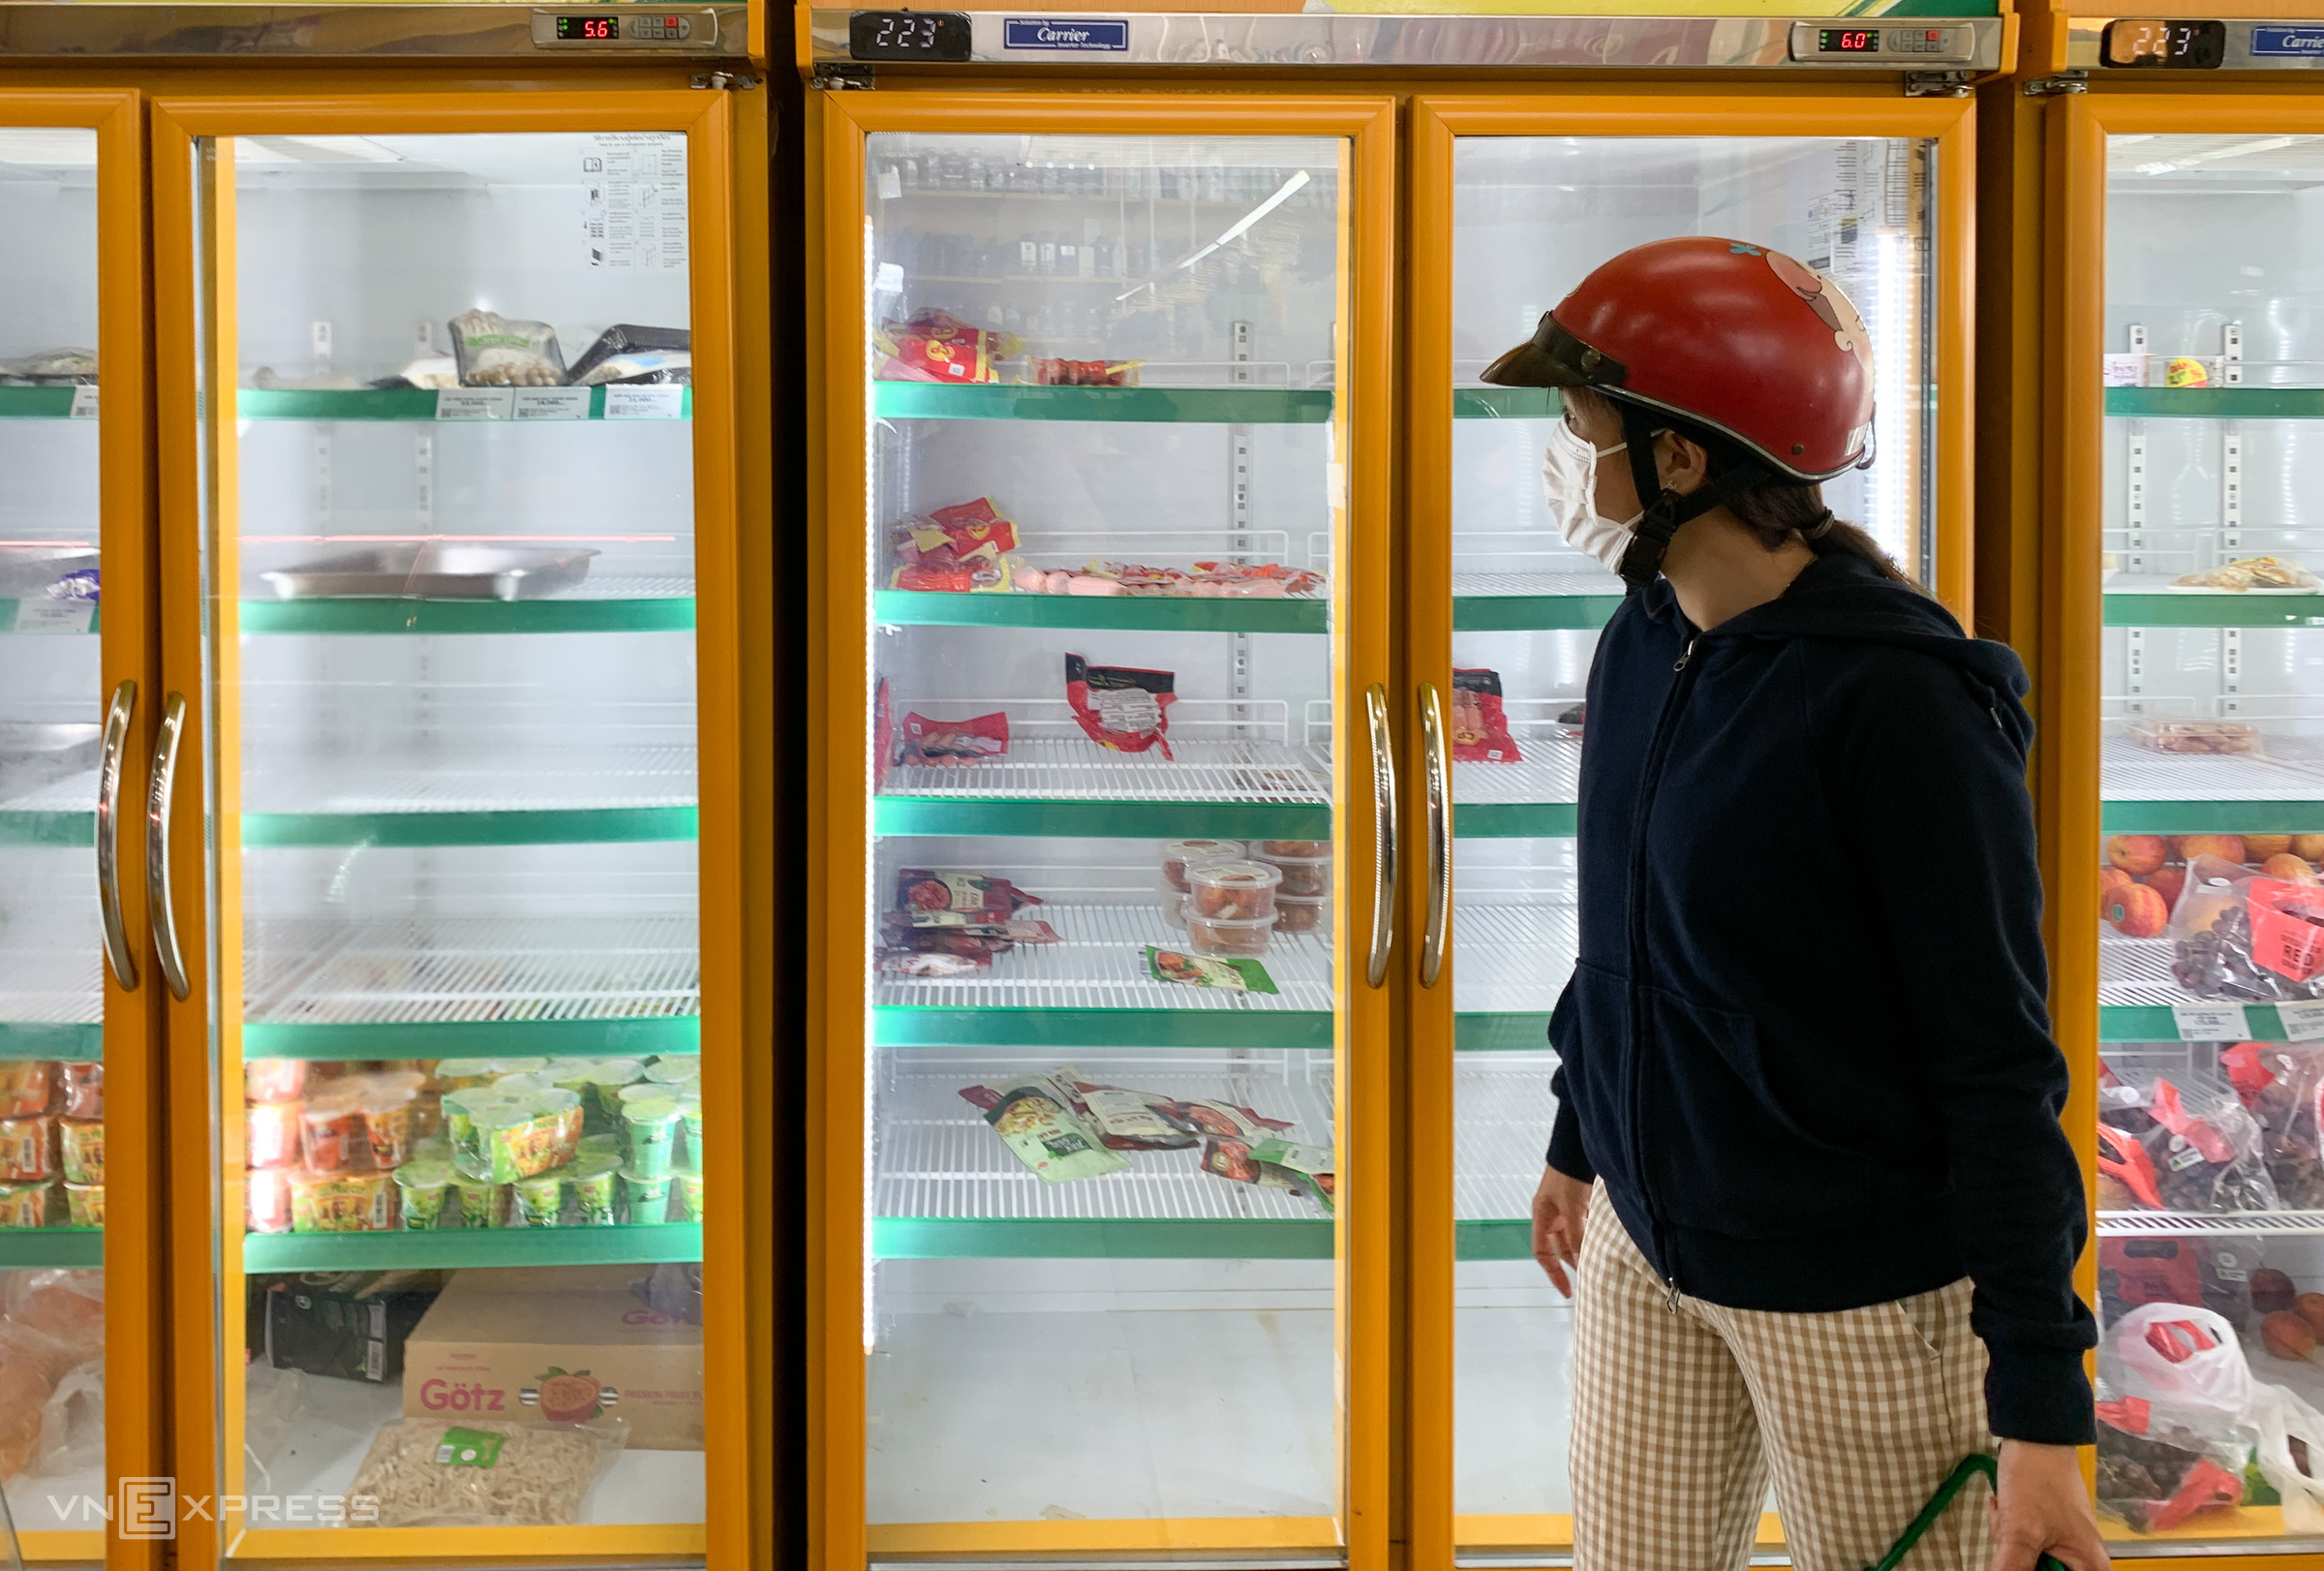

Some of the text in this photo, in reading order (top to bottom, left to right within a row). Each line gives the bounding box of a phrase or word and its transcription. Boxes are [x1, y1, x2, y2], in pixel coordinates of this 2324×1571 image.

[584, 20, 608, 38] 5.6
[876, 17, 936, 48] 223
[1037, 26, 1089, 43] Carrier
[1841, 32, 1866, 48] 6.0
[2132, 26, 2191, 55] 223
[2284, 944, 2314, 967] RED
[419, 1377, 505, 1412] Götz
